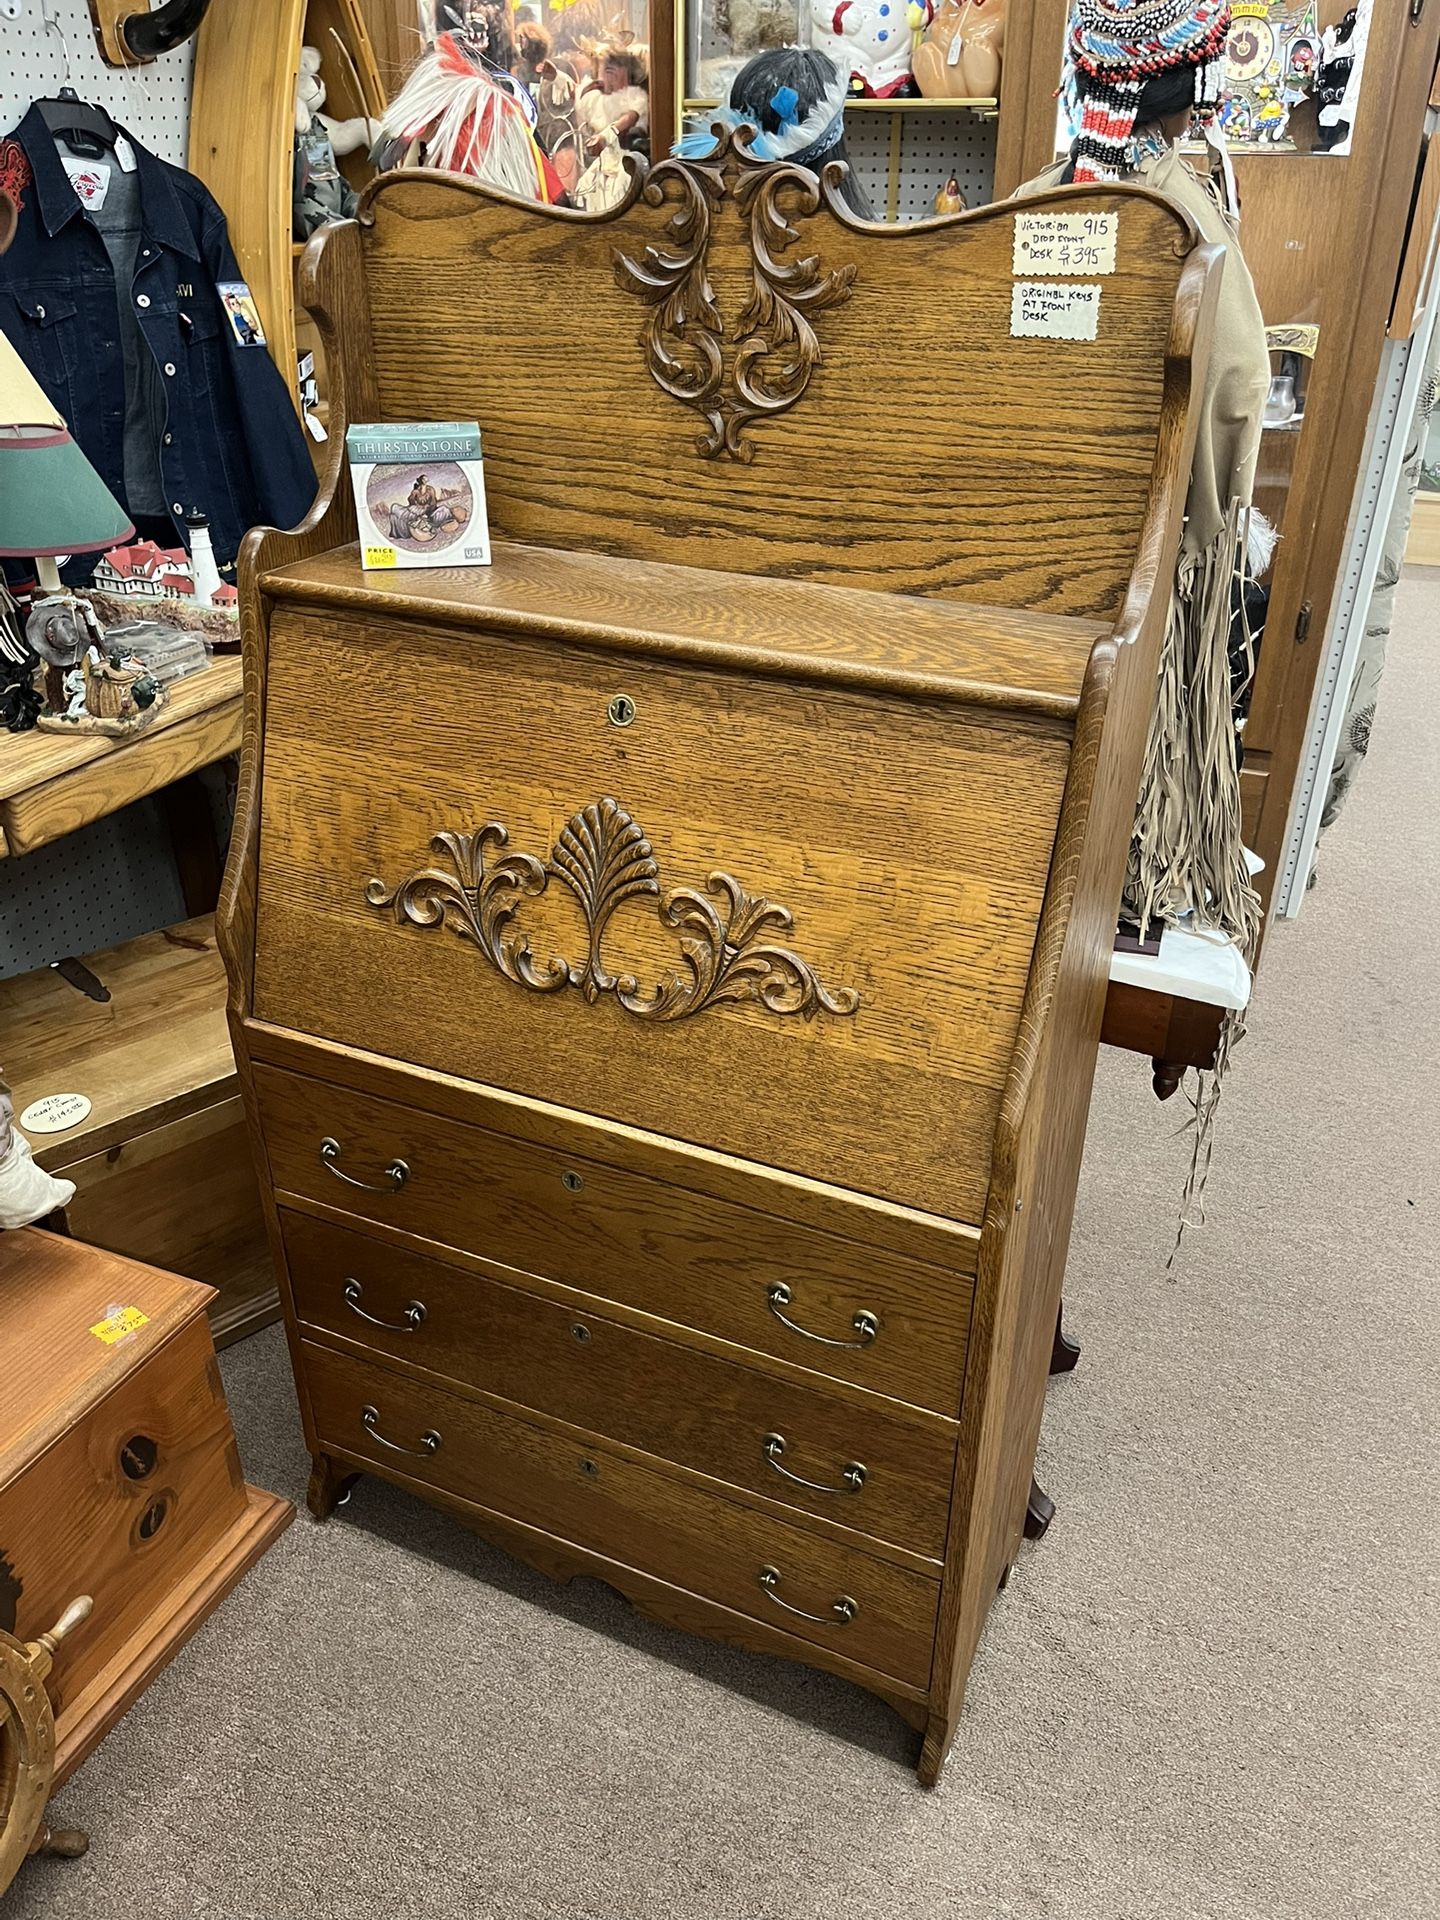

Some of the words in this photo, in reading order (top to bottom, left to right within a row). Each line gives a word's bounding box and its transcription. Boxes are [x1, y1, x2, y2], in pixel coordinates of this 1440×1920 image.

[1083, 218, 1109, 236] 915
[1022, 300, 1037, 309] AT
[354, 439, 474, 454] THIRSTYSTONE
[465, 549, 482, 558] USA
